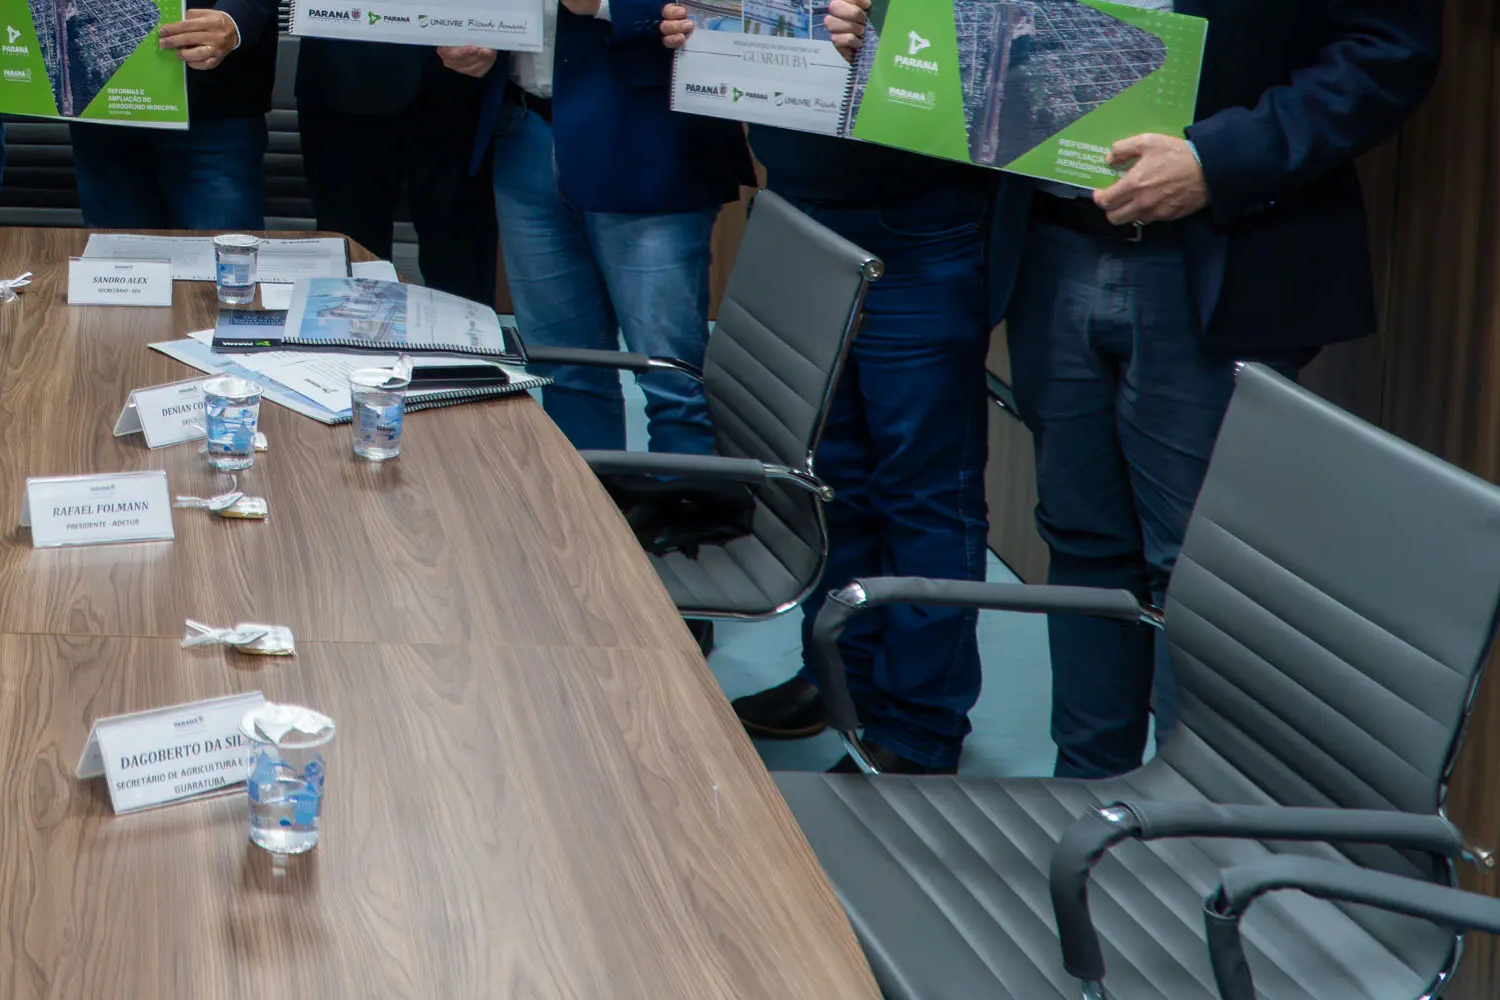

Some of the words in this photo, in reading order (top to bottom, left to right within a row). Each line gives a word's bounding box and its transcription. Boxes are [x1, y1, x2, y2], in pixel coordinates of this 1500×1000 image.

[308, 8, 350, 20] PARANÁ
[383, 15, 411, 23] PARANÁ
[430, 18, 463, 28] UNILIVRE
[2, 44, 29, 53] PARANÁ
[742, 51, 808, 69] GUARATUBA
[894, 54, 939, 72] PARANÁ
[685, 83, 719, 95] PARANÁ
[92, 276, 126, 285] SANDRO
[126, 277, 149, 285] ALEX
[161, 403, 192, 417] DENIAN
[52, 503, 94, 517] RAFAEL
[95, 501, 150, 514] FOLMANN
[66, 520, 107, 530] PRESIDENTE
[112, 518, 140, 528] ADETUR
[119, 742, 201, 770] DAGOBERTO
[203, 738, 224, 755] DA
[116, 771, 167, 791] SECRETÁRIO
[167, 770, 179, 780] DE
[180, 760, 237, 777] AGRICULTURA
[174, 776, 227, 795] GUARATUBA
